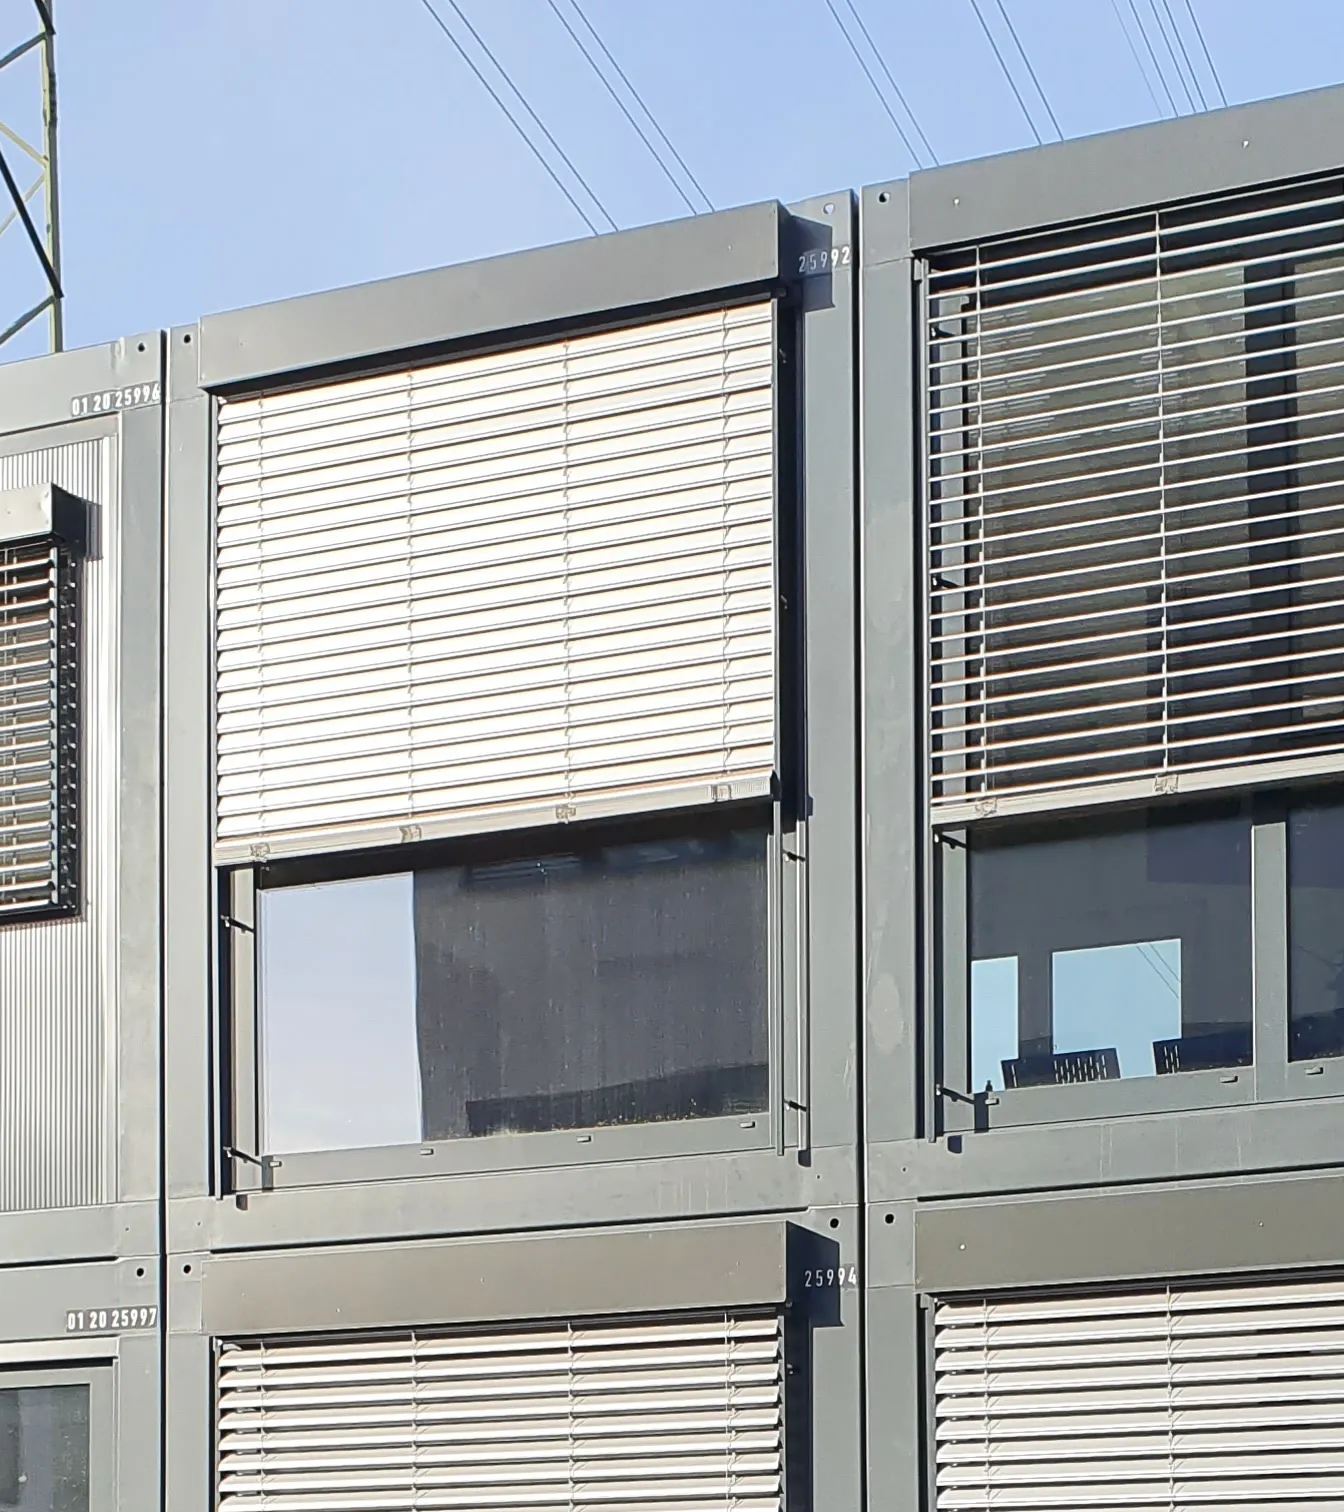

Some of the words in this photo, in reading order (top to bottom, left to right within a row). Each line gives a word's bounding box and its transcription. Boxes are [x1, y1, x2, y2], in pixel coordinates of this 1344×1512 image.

[798, 245, 850, 273] 25992
[71, 397, 88, 415] 01
[93, 392, 111, 412] 20
[115, 383, 161, 408] 25996
[804, 1266, 857, 1288] 25994
[67, 1312, 84, 1330] 01
[89, 1311, 107, 1329] 20
[111, 1308, 157, 1327] 25997
